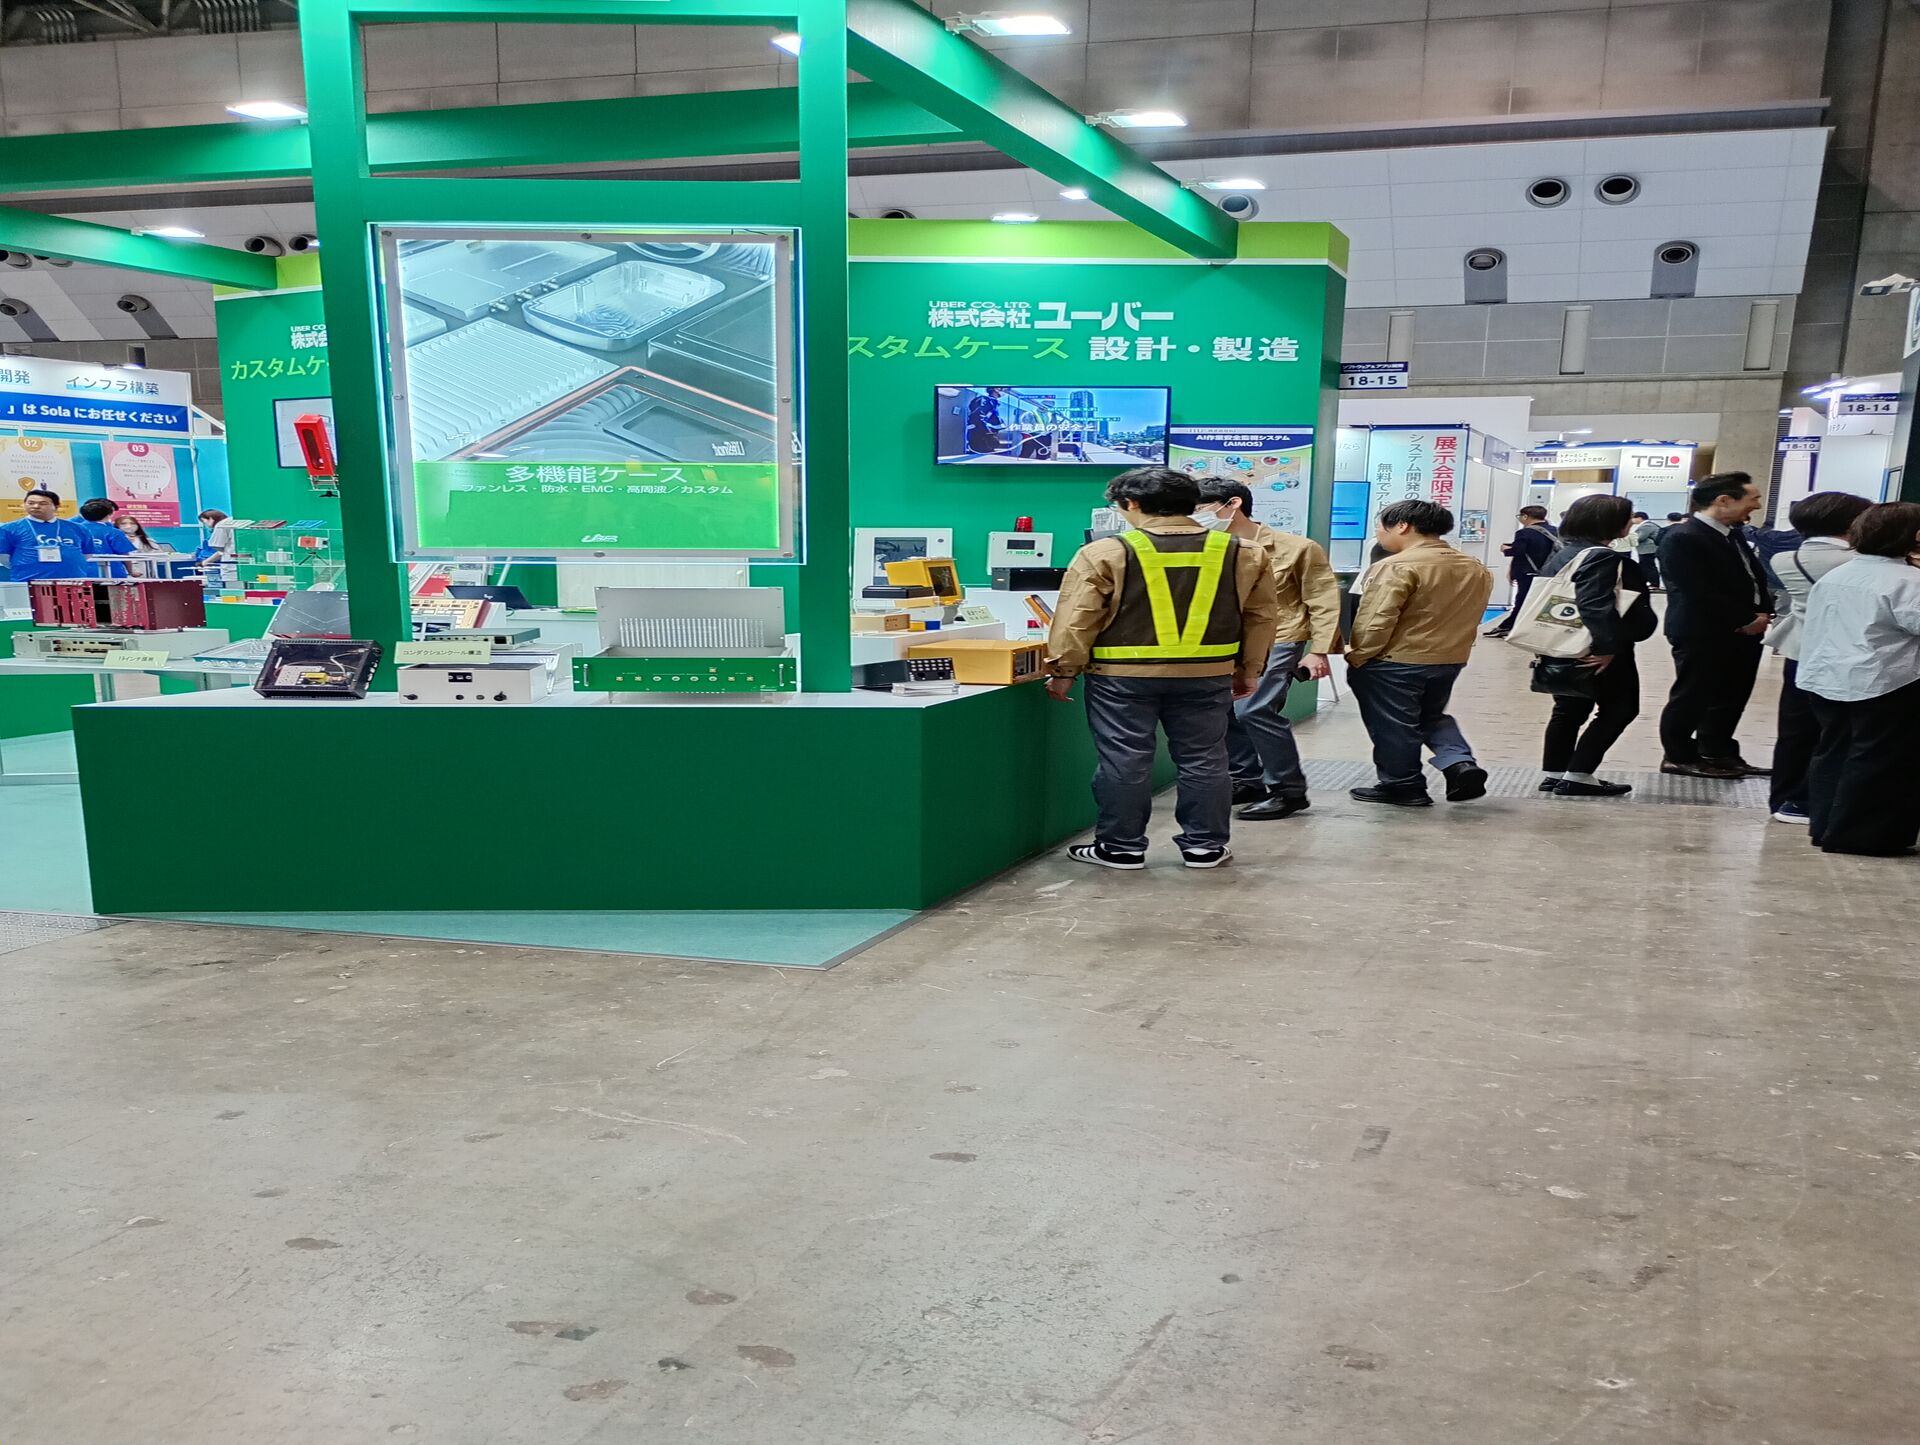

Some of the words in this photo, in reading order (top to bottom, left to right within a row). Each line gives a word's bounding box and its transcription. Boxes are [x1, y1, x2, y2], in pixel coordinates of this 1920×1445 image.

[1088, 336, 1299, 362] 設計・製造
[0, 369, 30, 384] 開発
[231, 356, 329, 380] カスタムケ
[66, 376, 159, 396] インフラ構築
[1348, 376, 1398, 386] 18-15
[40, 406, 71, 417] Sola
[74, 407, 178, 424] にお任せください
[132, 444, 145, 453] 03
[506, 466, 687, 484] 多機能ケース
